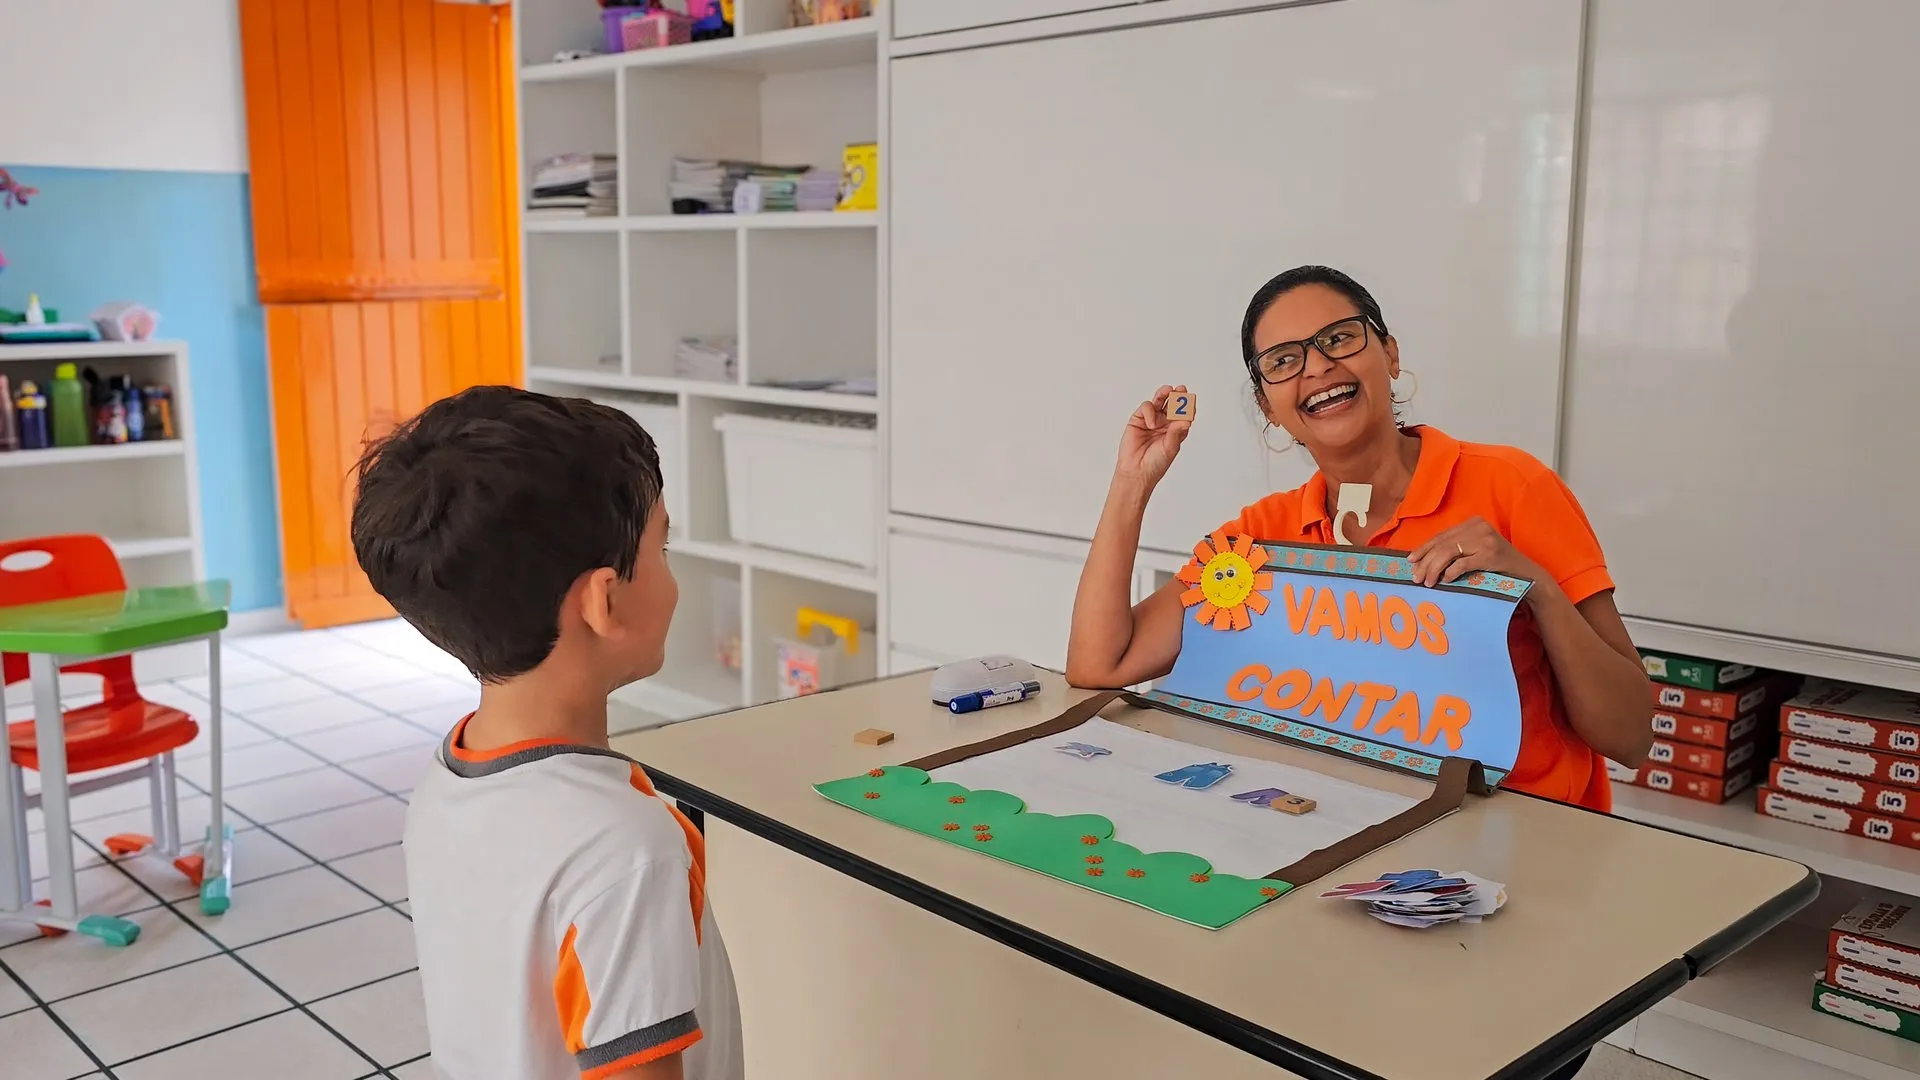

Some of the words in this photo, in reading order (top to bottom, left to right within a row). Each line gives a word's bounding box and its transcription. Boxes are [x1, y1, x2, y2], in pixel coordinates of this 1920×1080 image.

[1175, 396, 1188, 415] 2
[1283, 583, 1449, 655] VAMOS
[1668, 693, 1682, 703] 5
[1225, 663, 1472, 752] CONTAR
[1660, 720, 1673, 729] 5
[1899, 735, 1915, 746] 5
[1657, 747, 1670, 757] 5
[1899, 767, 1915, 778] 5
[1656, 775, 1669, 785] 5
[1886, 796, 1902, 807] 5
[1873, 823, 1889, 835] 5
